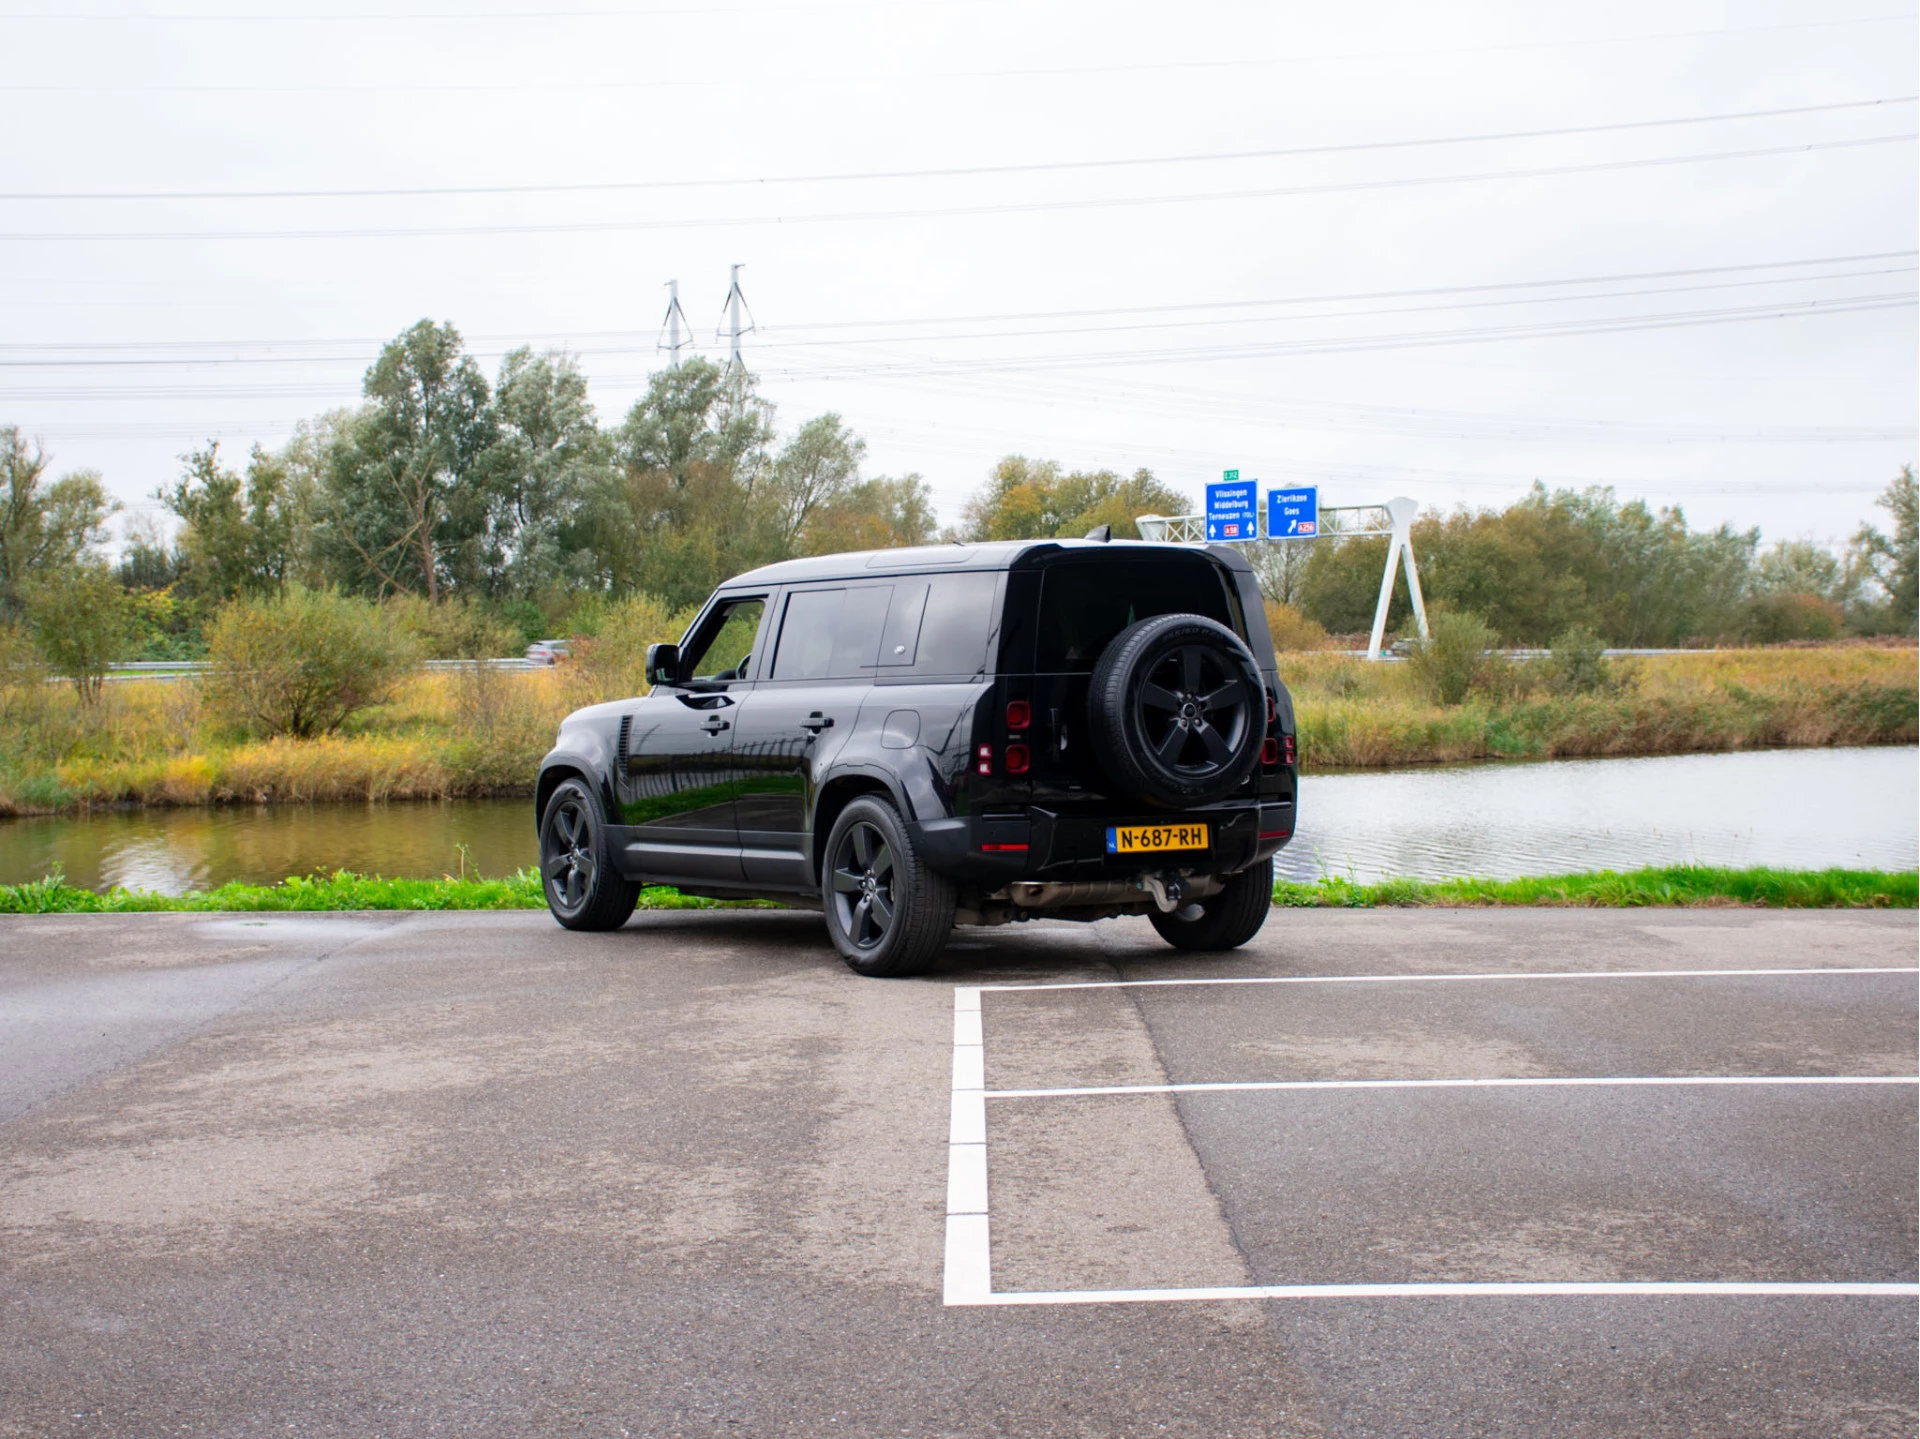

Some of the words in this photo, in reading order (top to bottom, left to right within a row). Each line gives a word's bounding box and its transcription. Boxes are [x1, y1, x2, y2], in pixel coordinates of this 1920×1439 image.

[1215, 489, 1247, 498] Vlissingen
[1277, 495, 1307, 503] Zierikzee
[1214, 500, 1248, 509] Middelburg
[1209, 511, 1240, 520] Terneuzen
[1284, 507, 1300, 515] Goes
[1121, 827, 1202, 849] N-687-RH
